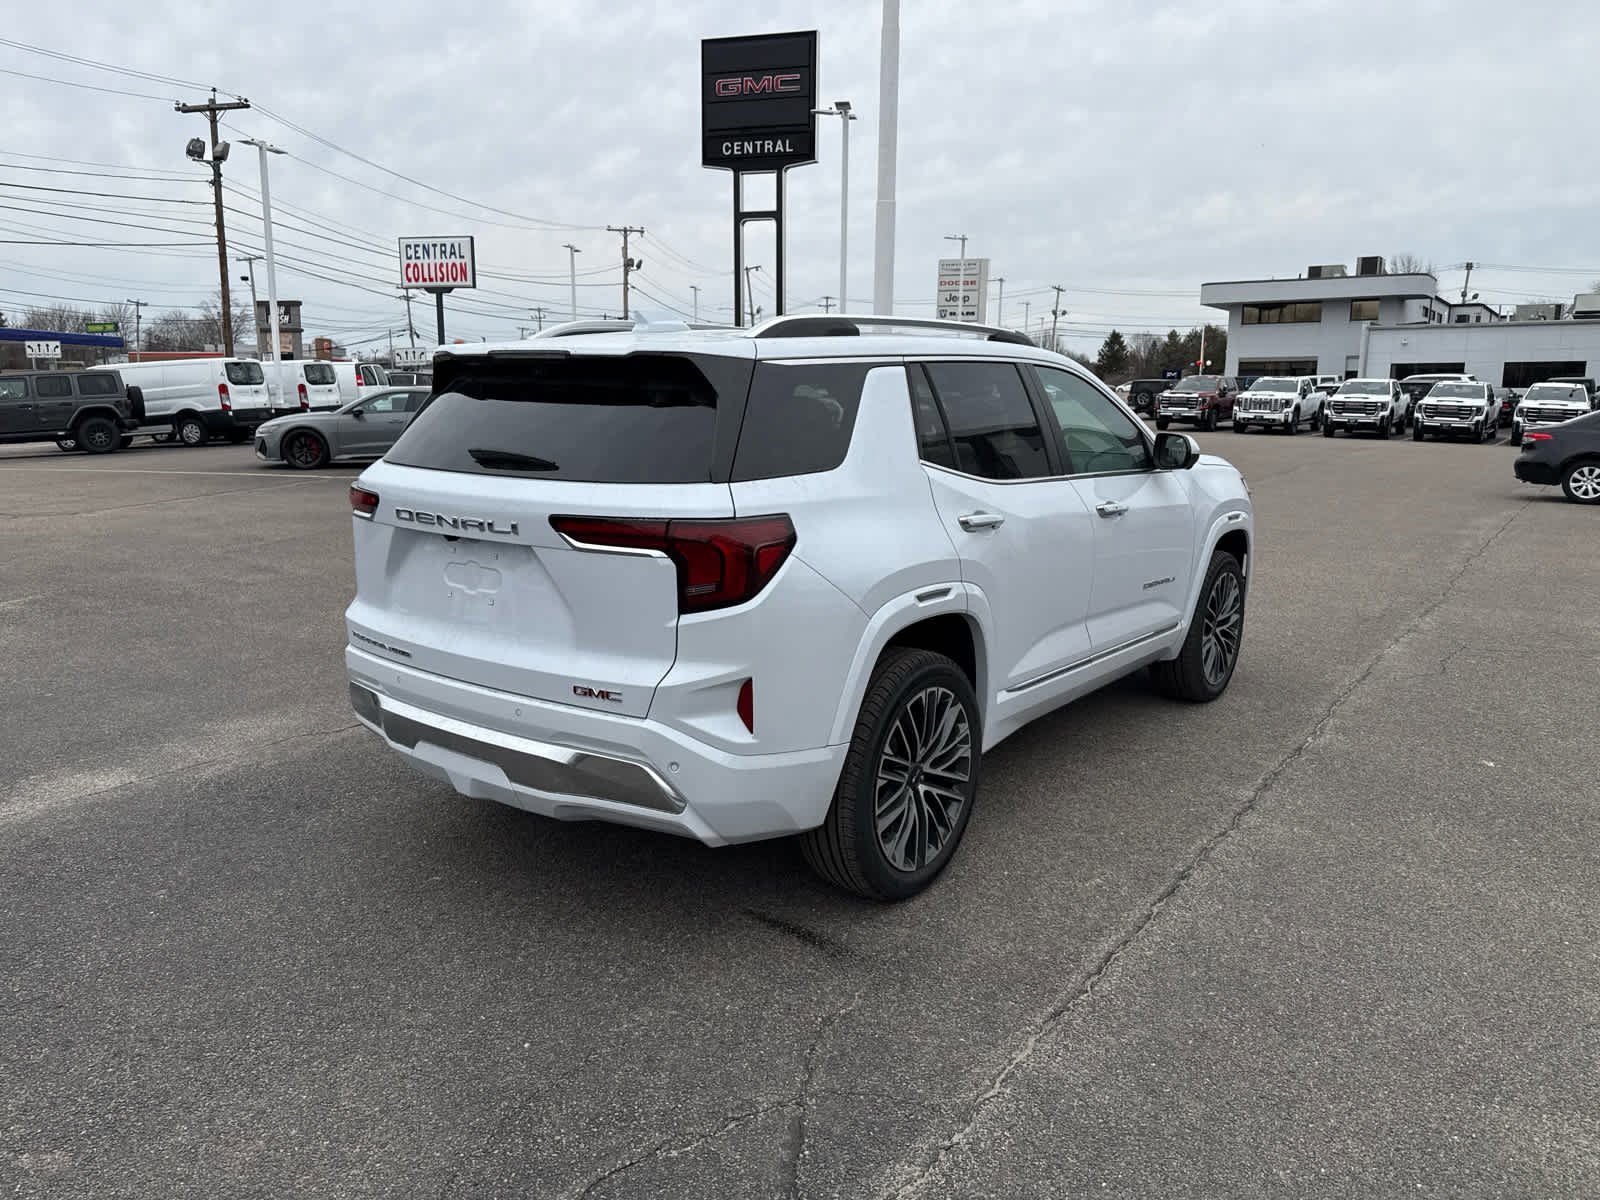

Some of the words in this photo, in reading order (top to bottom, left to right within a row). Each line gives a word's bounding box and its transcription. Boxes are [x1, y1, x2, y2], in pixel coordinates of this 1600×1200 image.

[715, 74, 800, 96] GMC
[722, 139, 794, 156] CENTRAL
[405, 243, 465, 260] CENTRAL
[405, 261, 468, 283] COLLISION
[395, 507, 519, 536] DENALI
[572, 685, 623, 703] GMC
